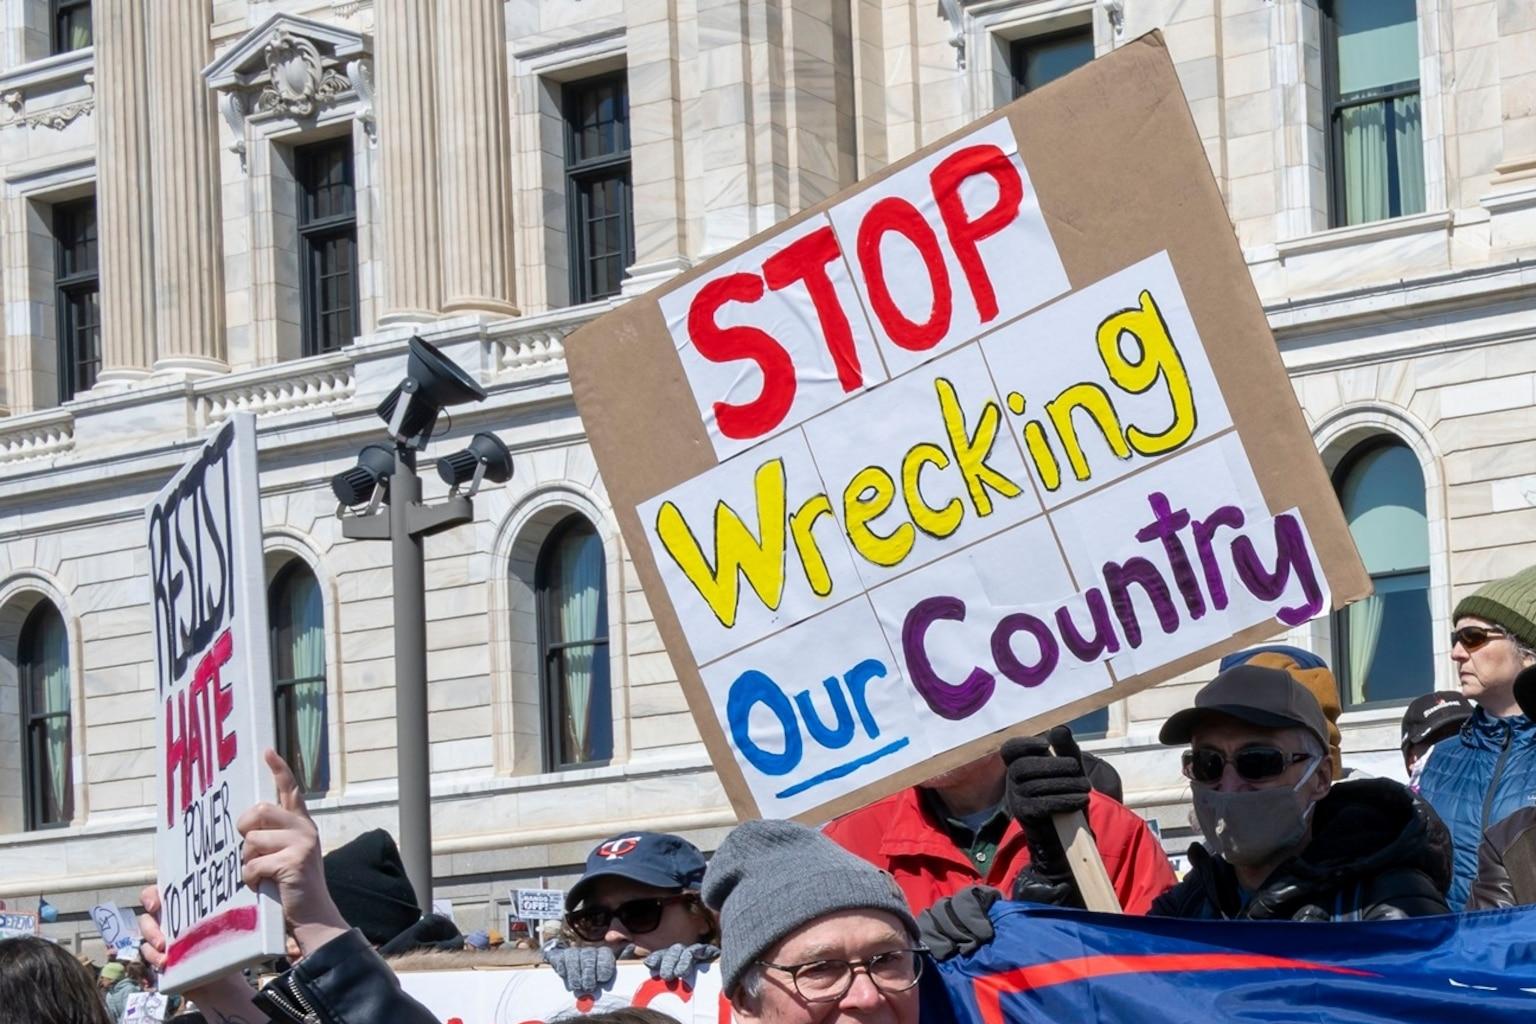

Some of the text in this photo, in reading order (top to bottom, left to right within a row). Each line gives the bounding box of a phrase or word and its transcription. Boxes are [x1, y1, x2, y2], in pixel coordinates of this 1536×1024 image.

[687, 143, 1024, 440] STOP
[149, 421, 234, 701] RESIST
[656, 290, 1198, 628] Wrecking
[166, 627, 238, 829] HATE
[725, 492, 1331, 777] Our Country
[164, 883, 181, 938] TO
[182, 866, 208, 927] THE
[184, 780, 235, 875] POWER
